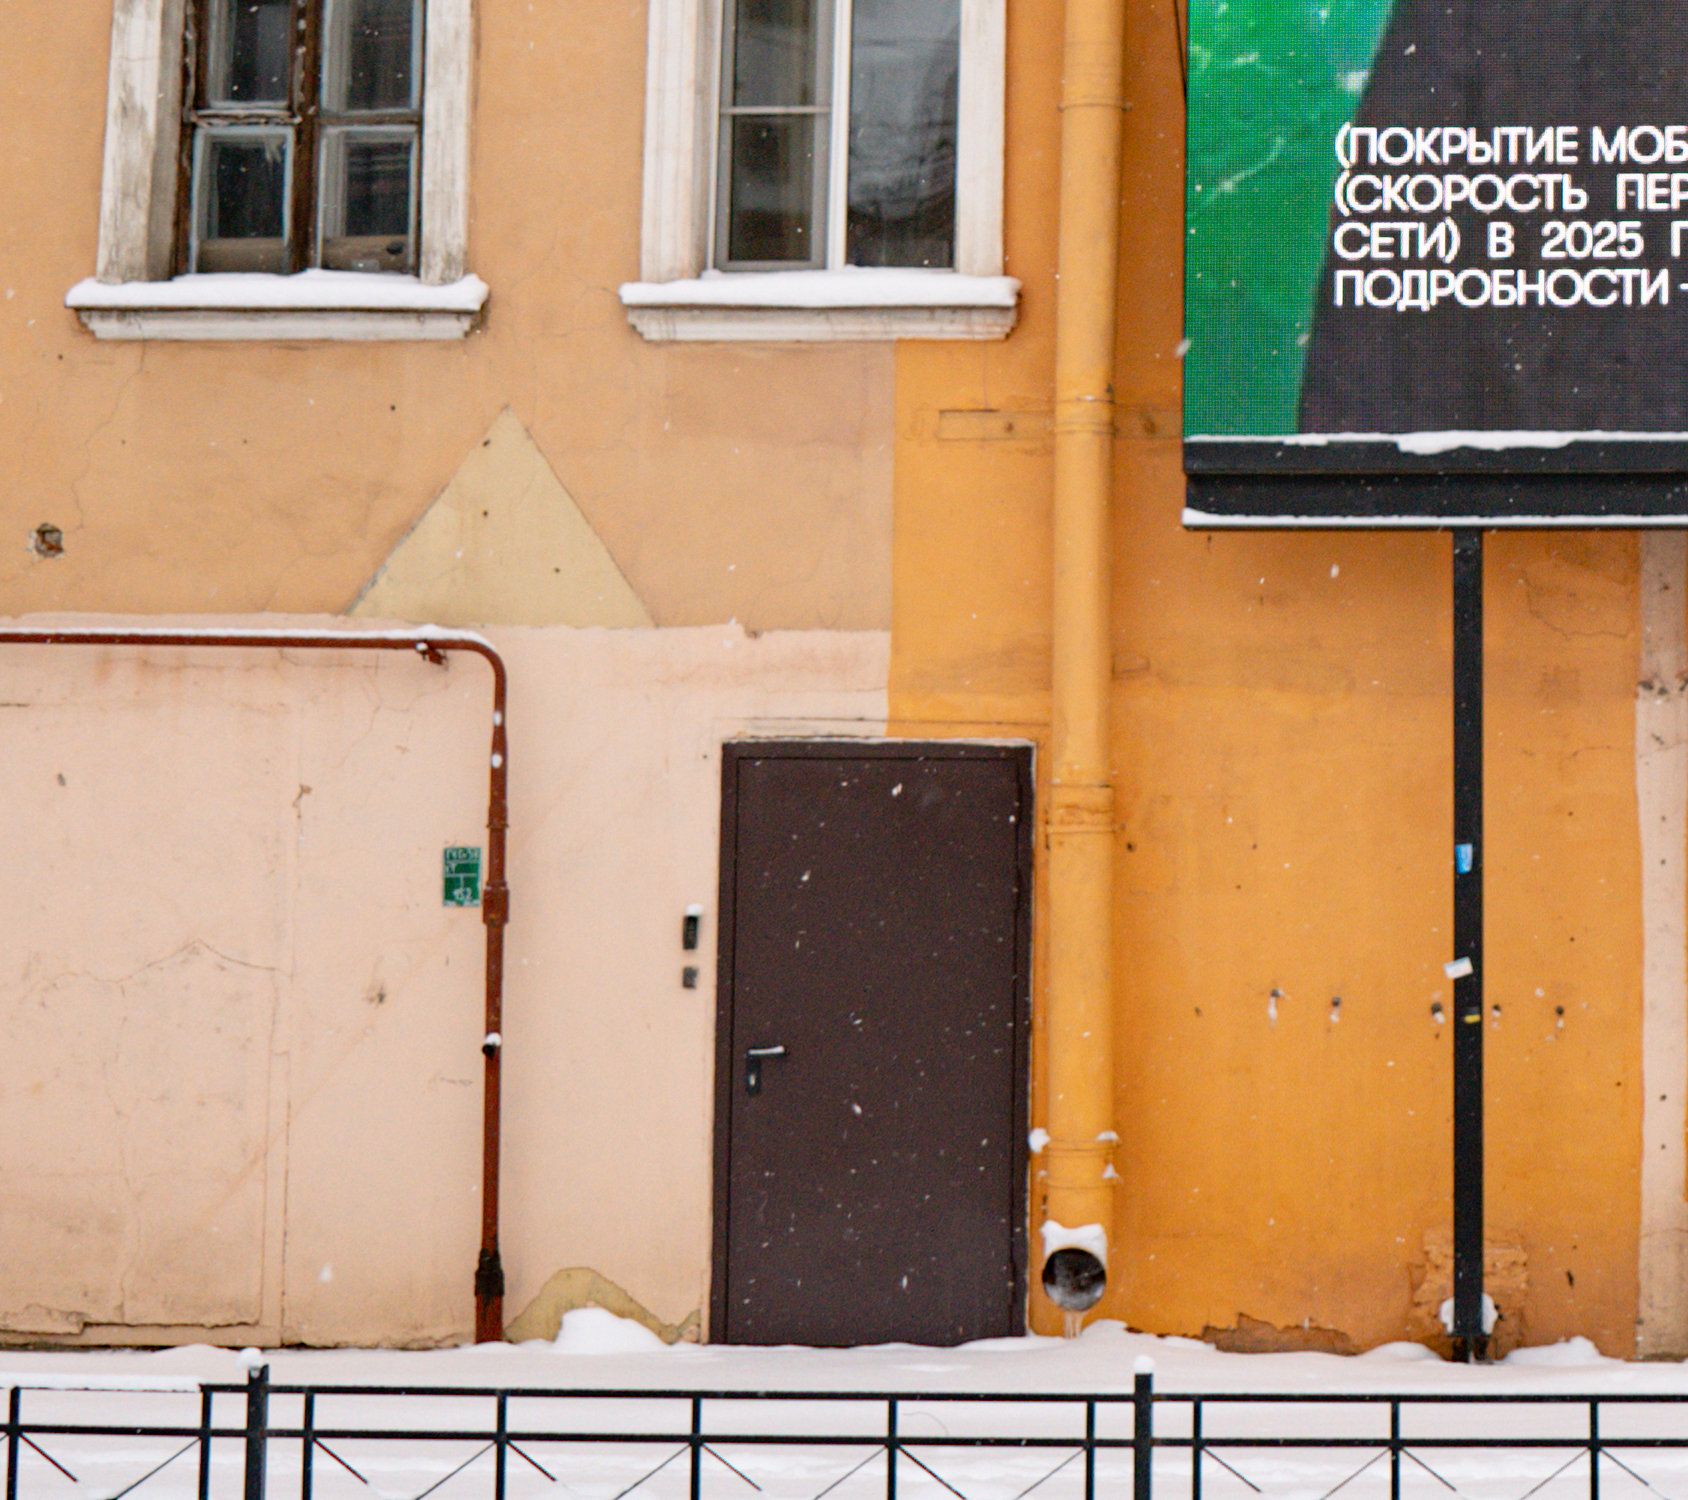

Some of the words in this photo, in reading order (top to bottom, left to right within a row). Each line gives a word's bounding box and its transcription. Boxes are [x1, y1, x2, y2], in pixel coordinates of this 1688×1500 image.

[1335, 122, 1578, 169] (ПОКРЫТИЕ
[1335, 169, 1589, 216] (СКОРОСТЬ
[1334, 217, 1460, 263] СЕТИ)
[1488, 222, 1514, 259] В
[1541, 221, 1644, 259] 2025
[1334, 268, 1669, 311] ПОДРОБНОСТИ
